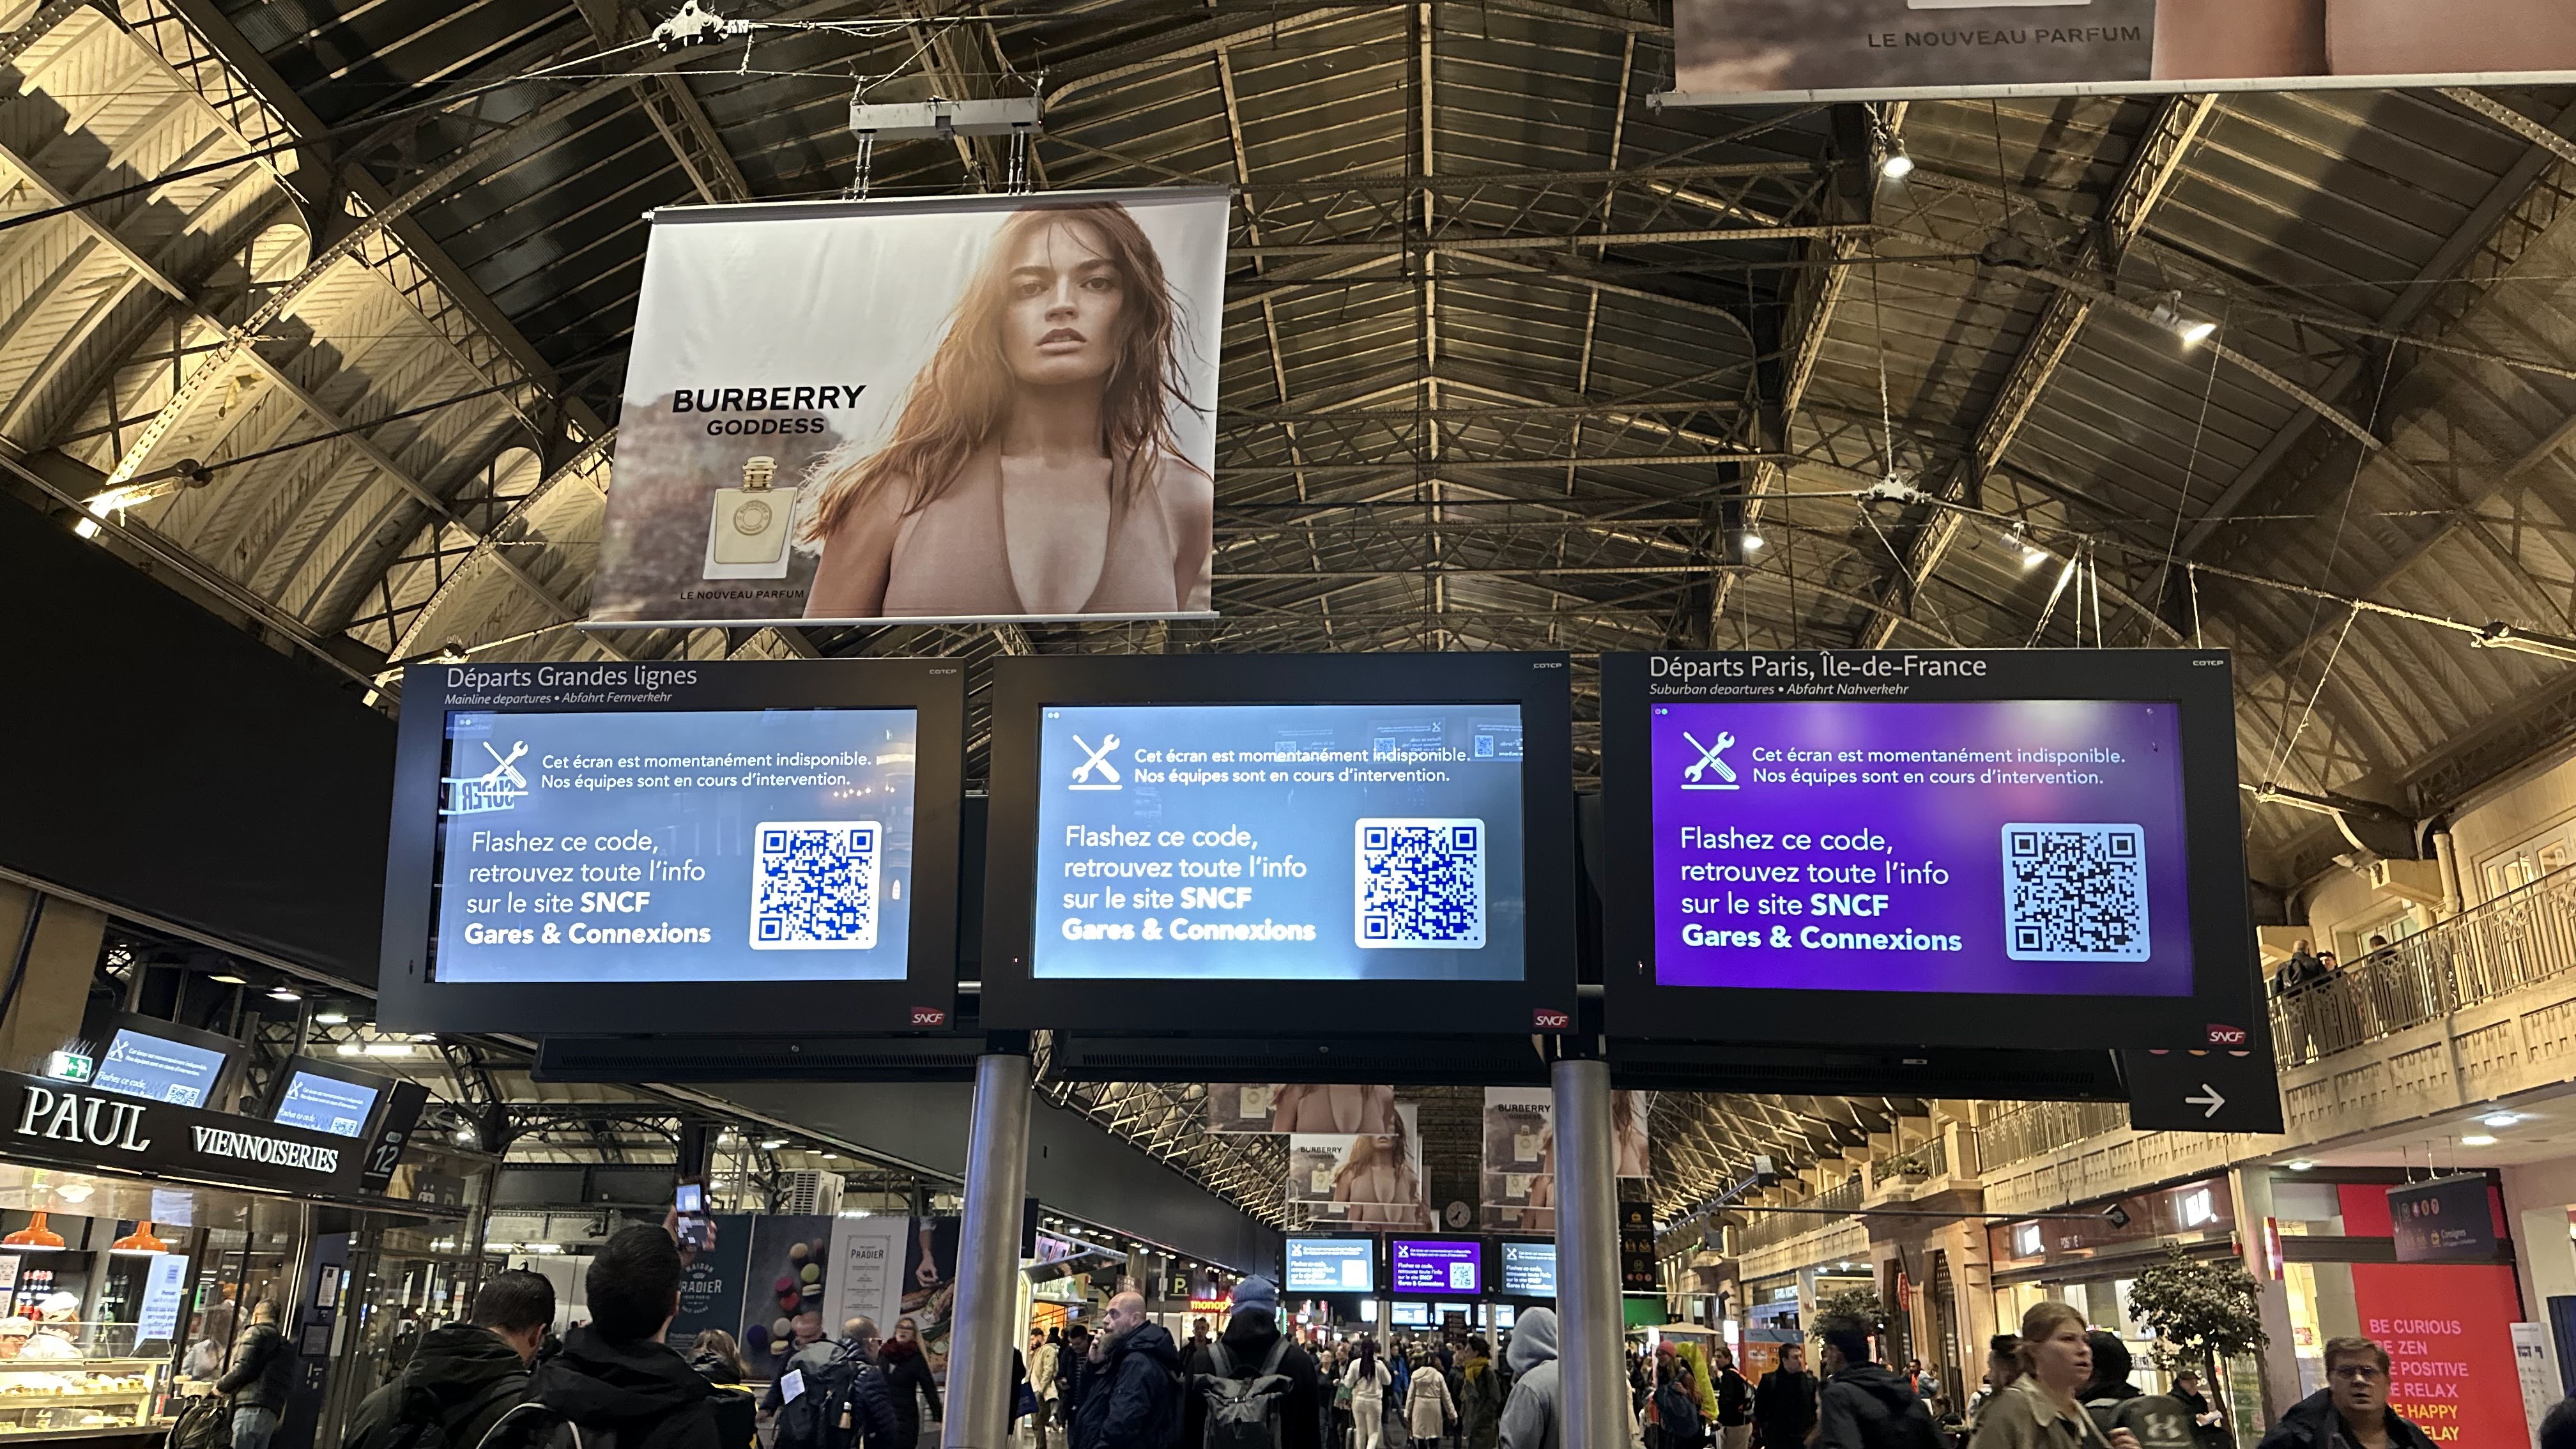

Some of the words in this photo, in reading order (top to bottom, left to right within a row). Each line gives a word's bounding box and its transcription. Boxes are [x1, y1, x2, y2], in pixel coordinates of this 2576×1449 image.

[1868, 31, 1897, 48] LE
[1905, 28, 2025, 47] NOUVEAU
[2035, 27, 2140, 43] PARFUM
[673, 385, 866, 411] BURBERRY
[707, 418, 824, 435] GODDESS
[680, 592, 693, 601] LE
[696, 590, 753, 600] NOUVEAU
[756, 589, 804, 599] PARFUM
[1651, 656, 1744, 682] Départs
[1752, 656, 1814, 680] Paris,
[1820, 650, 1986, 676] Île-de-France
[448, 668, 531, 692] Départs
[538, 666, 627, 686] Grandes
[635, 666, 696, 691] lignes
[1650, 684, 1706, 694] Suburban
[1710, 684, 1774, 694] departures
[1787, 684, 1834, 694] Abfahrt
[1837, 684, 1909, 694] Nahverkehr
[445, 694, 491, 704] Mainline
[493, 694, 551, 706] departures
[562, 693, 604, 703] Abfahrt
[607, 692, 672, 702] Fernverkehr
[543, 755, 569, 768] Cet
[573, 755, 612, 768] écran
[618, 756, 640, 767] est
[645, 753, 772, 767] momentanément
[777, 751, 871, 769] indisponible.
[1135, 749, 1162, 762] Cet
[1167, 749, 1207, 762] écran
[1212, 751, 1234, 762] est
[1239, 748, 1368, 762] momentanément
[1374, 747, 1470, 765] indisponible.
[1752, 747, 1782, 762] Cet
[1788, 747, 1832, 762] écran
[1838, 749, 1863, 762] est
[1868, 748, 2012, 762] momentanément
[2018, 747, 2125, 766] indisponible.
[542, 775, 570, 788] Nos
[575, 774, 632, 791] équipes
[638, 776, 670, 787] sont
[674, 778, 691, 786] en
[697, 777, 737, 786] cours
[742, 772, 850, 786] d'intervention.
[1135, 769, 1164, 782] Nos
[1169, 769, 1229, 786] équipes
[1232, 770, 1266, 782] sont
[1270, 772, 1288, 781] en
[1294, 772, 1334, 781] cours
[1339, 767, 1449, 781] d'intervention.
[1754, 768, 1786, 782] Nos
[1791, 768, 1857, 786] équipes
[1862, 770, 1899, 783] sont
[1904, 773, 1924, 783] en
[1930, 773, 1975, 783] cours
[1981, 769, 2103, 784] d'intervention.
[473, 831, 554, 852] Flashez
[562, 837, 586, 851] ce
[595, 829, 657, 854] code,
[1067, 825, 1151, 846] Flashez
[1158, 832, 1184, 846] ce
[1193, 824, 1257, 849] code,
[1682, 826, 1774, 849] Flashez
[1782, 834, 1811, 850] ce
[1821, 828, 1892, 854] code,
[470, 865, 573, 882] retrouvez
[581, 864, 641, 882] toute
[650, 859, 705, 880] l'info
[1065, 859, 1172, 877] retrouvez
[1179, 859, 1241, 877] toute
[1250, 855, 1306, 877] l'info
[1682, 862, 1799, 882] retrouvez
[1807, 864, 1876, 883] toute
[1886, 861, 1949, 884] l'info
[467, 899, 501, 913] sur
[508, 891, 526, 912] le
[534, 893, 573, 912] site
[580, 891, 650, 912] SNCF
[1063, 892, 1099, 908] sur
[1105, 887, 1126, 908] le
[1133, 887, 1174, 908] site
[1181, 887, 1252, 908] SNCF
[1682, 898, 1720, 913] sur
[1728, 891, 1749, 914] le
[1758, 893, 1802, 915] site
[1811, 893, 1889, 916] SNCF
[465, 923, 533, 944] Gares
[542, 923, 561, 944] &
[569, 922, 710, 944] Connexions
[1063, 918, 1134, 940] Gares
[1142, 919, 1161, 939] &
[1170, 918, 1315, 940] Connexions
[1682, 924, 1761, 947] Gares
[1770, 925, 1792, 947] &
[1800, 926, 1962, 951] Connexions
[912, 1013, 944, 1023] SNCF
[1535, 1015, 1568, 1026] SNCF
[2209, 1031, 2244, 1042] SNCF
[1498, 1104, 1551, 1113] BURBERRY
[17, 1085, 151, 1152] PAUL
[192, 1125, 339, 1174] VIENNOISERIES
[374, 1144, 399, 1173] 12
[851, 1248, 884, 1259] PRADIER
[679, 1279, 722, 1293] RADIER
[2369, 1319, 2390, 1333] BE
[2394, 1319, 2462, 1335] CURIOUS
[2398, 1340, 2428, 1355] ZEN
[2400, 1361, 2469, 1377] POSITIVE
[2404, 1383, 2459, 1398] RELAX
[2407, 1404, 2458, 1419] HAPPY
[2421, 1425, 2459, 1441] ELAY
